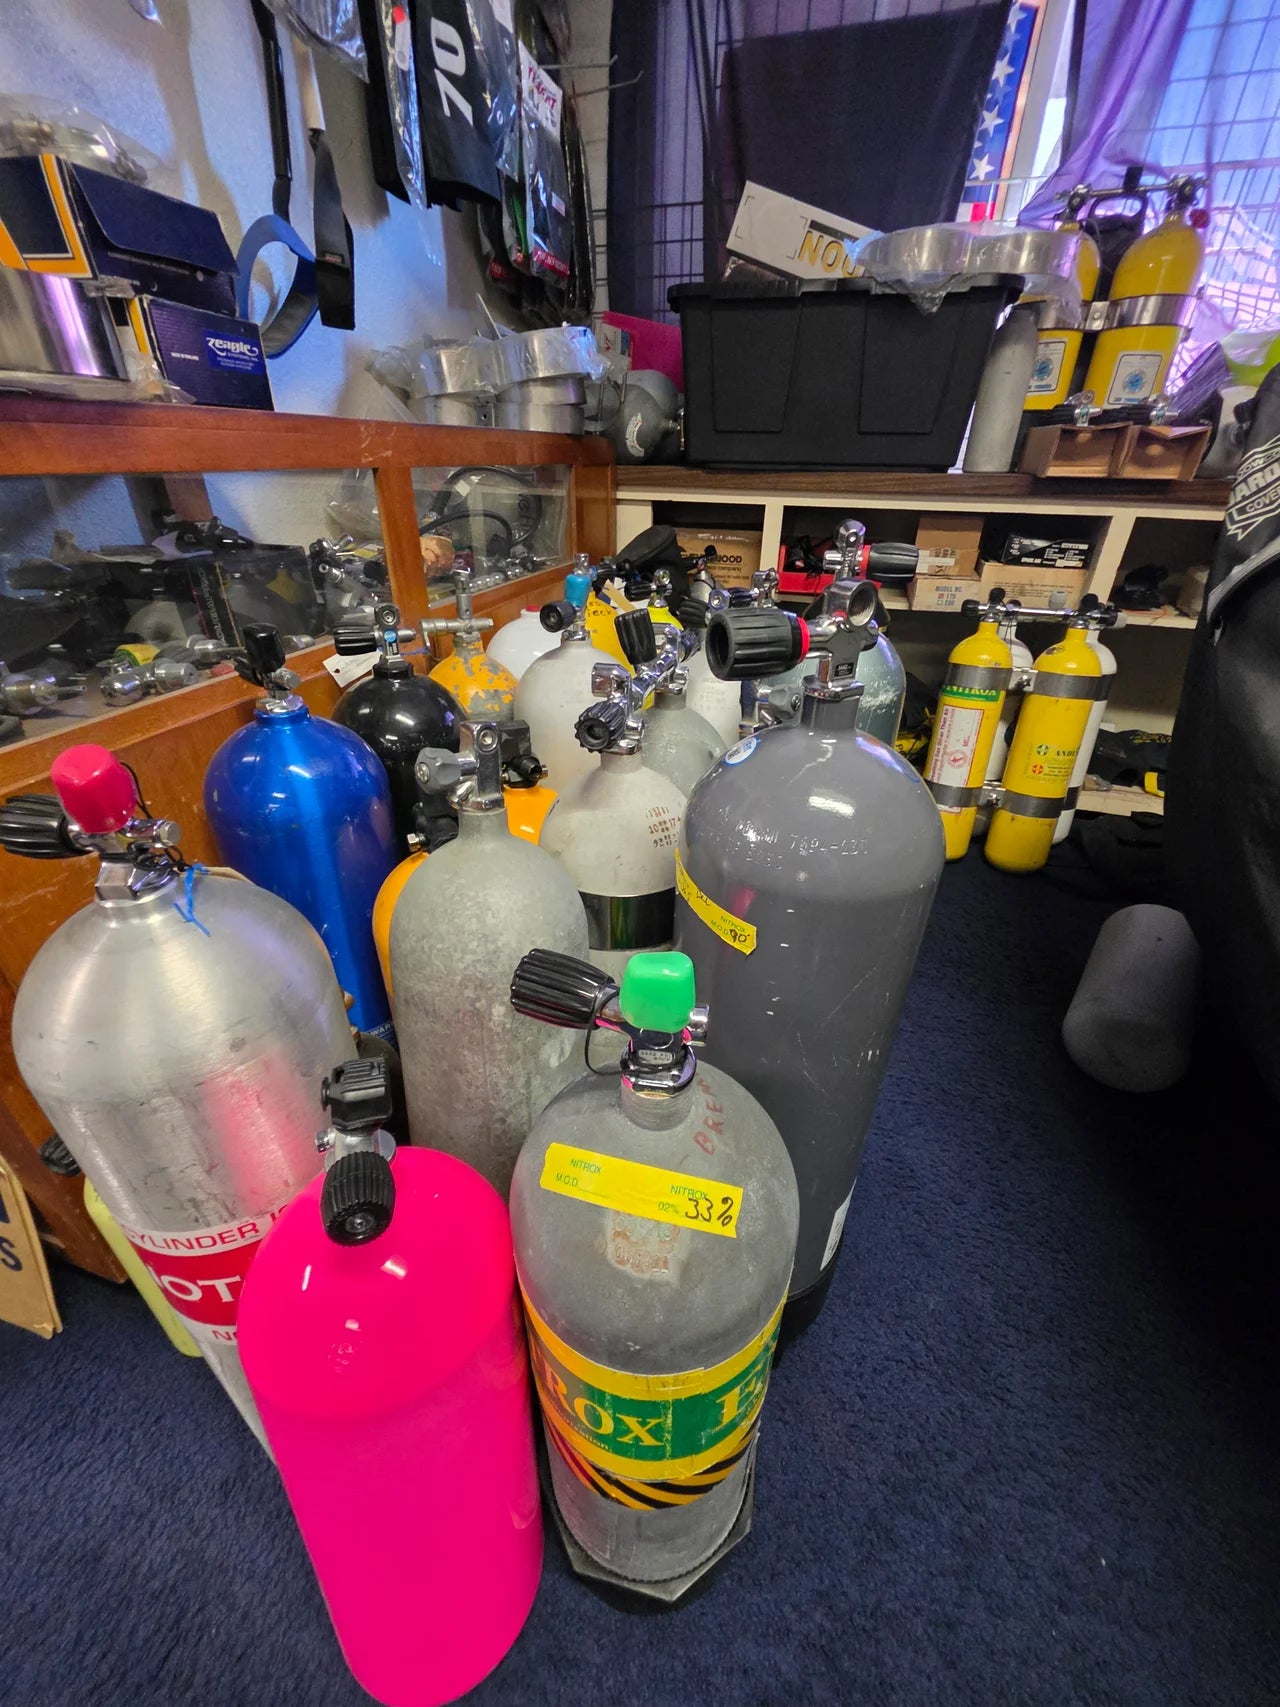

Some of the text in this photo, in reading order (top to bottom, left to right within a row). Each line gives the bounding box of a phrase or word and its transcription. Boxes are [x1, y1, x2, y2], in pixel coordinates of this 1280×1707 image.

[430, 16, 474, 127] 70
[569, 1158, 602, 1174] NITROX
[670, 1184, 709, 1200] NITROX
